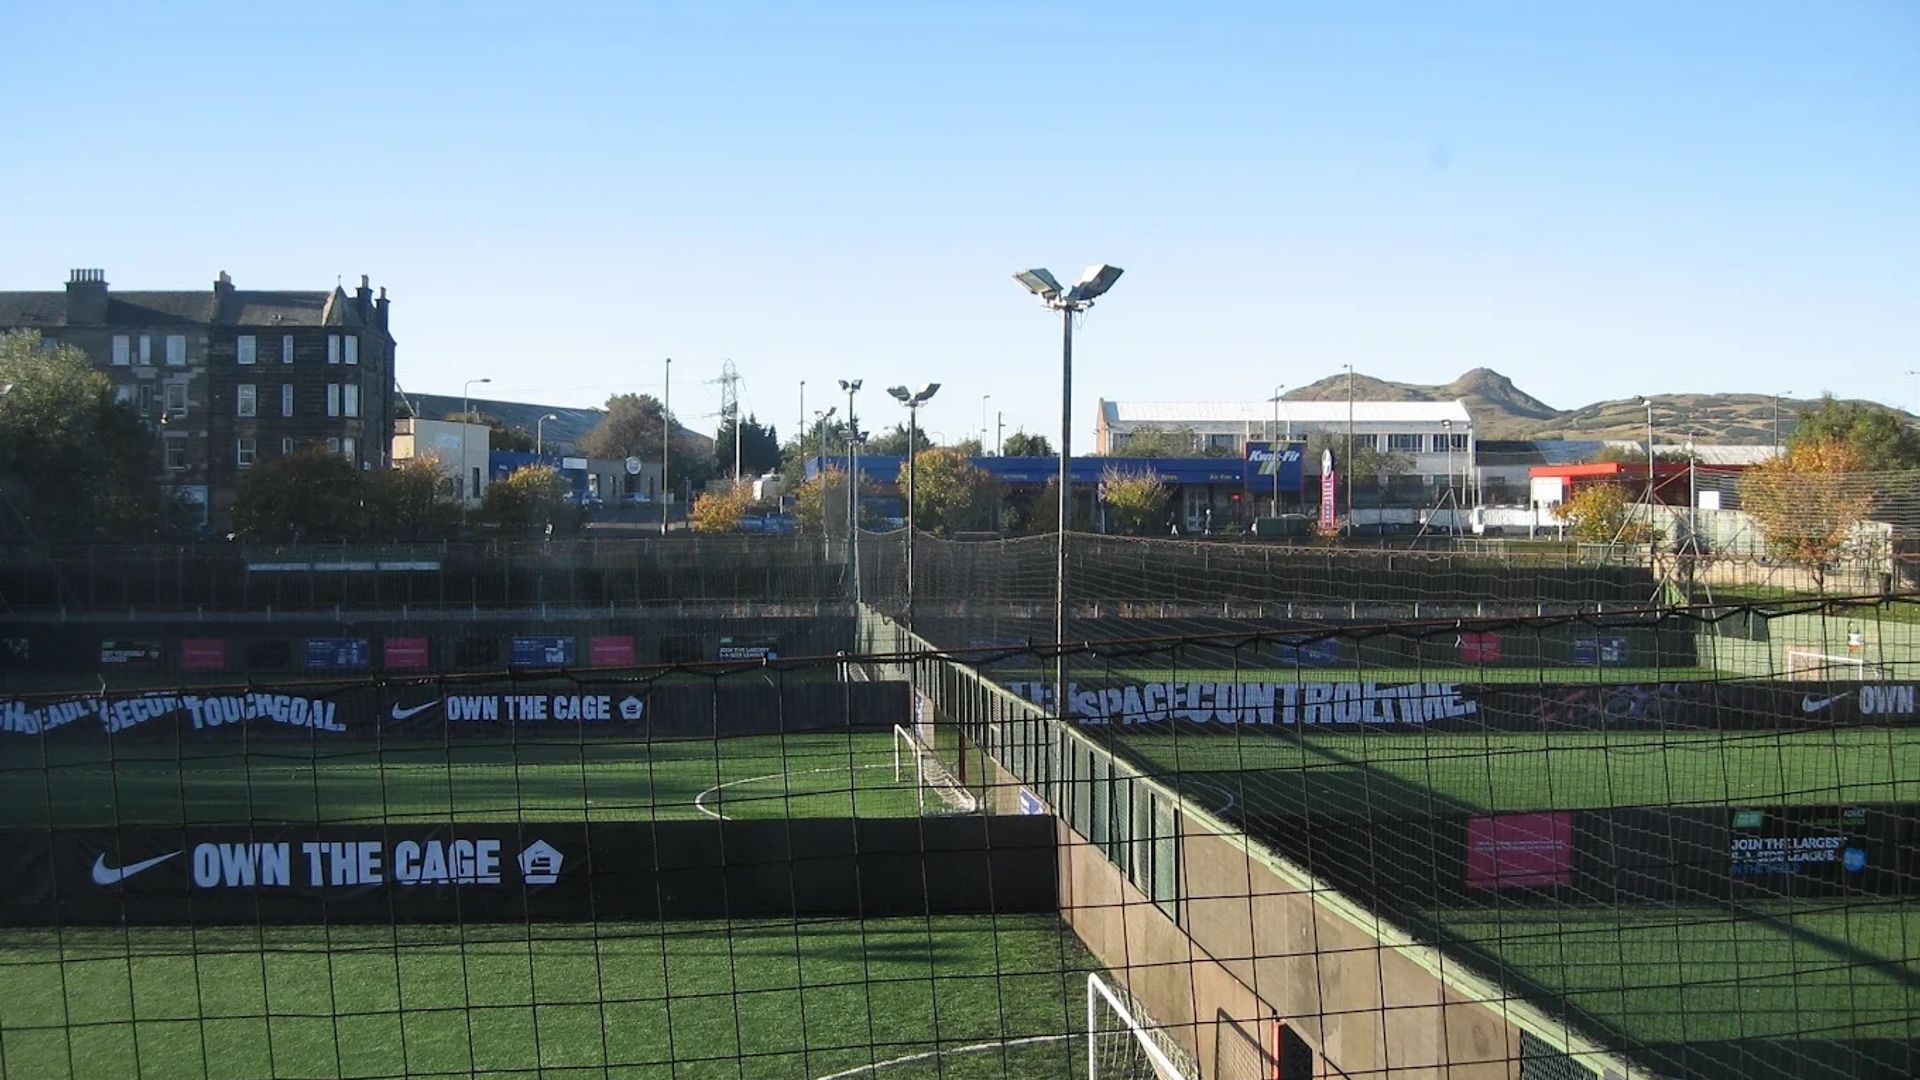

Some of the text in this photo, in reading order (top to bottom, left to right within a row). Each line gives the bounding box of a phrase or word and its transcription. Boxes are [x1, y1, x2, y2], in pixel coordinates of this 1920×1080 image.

[100, 692, 186, 733] SECON
[184, 693, 271, 730] TOUCH
[447, 695, 611, 720] OWN THE CAGE
[1076, 682, 1187, 724] SPACE
[1187, 682, 1383, 723] CONTROL
[1859, 685, 1913, 714] OWN
[1731, 839, 1764, 851] JOIN
[193, 839, 500, 887] OWN THE CAGE
